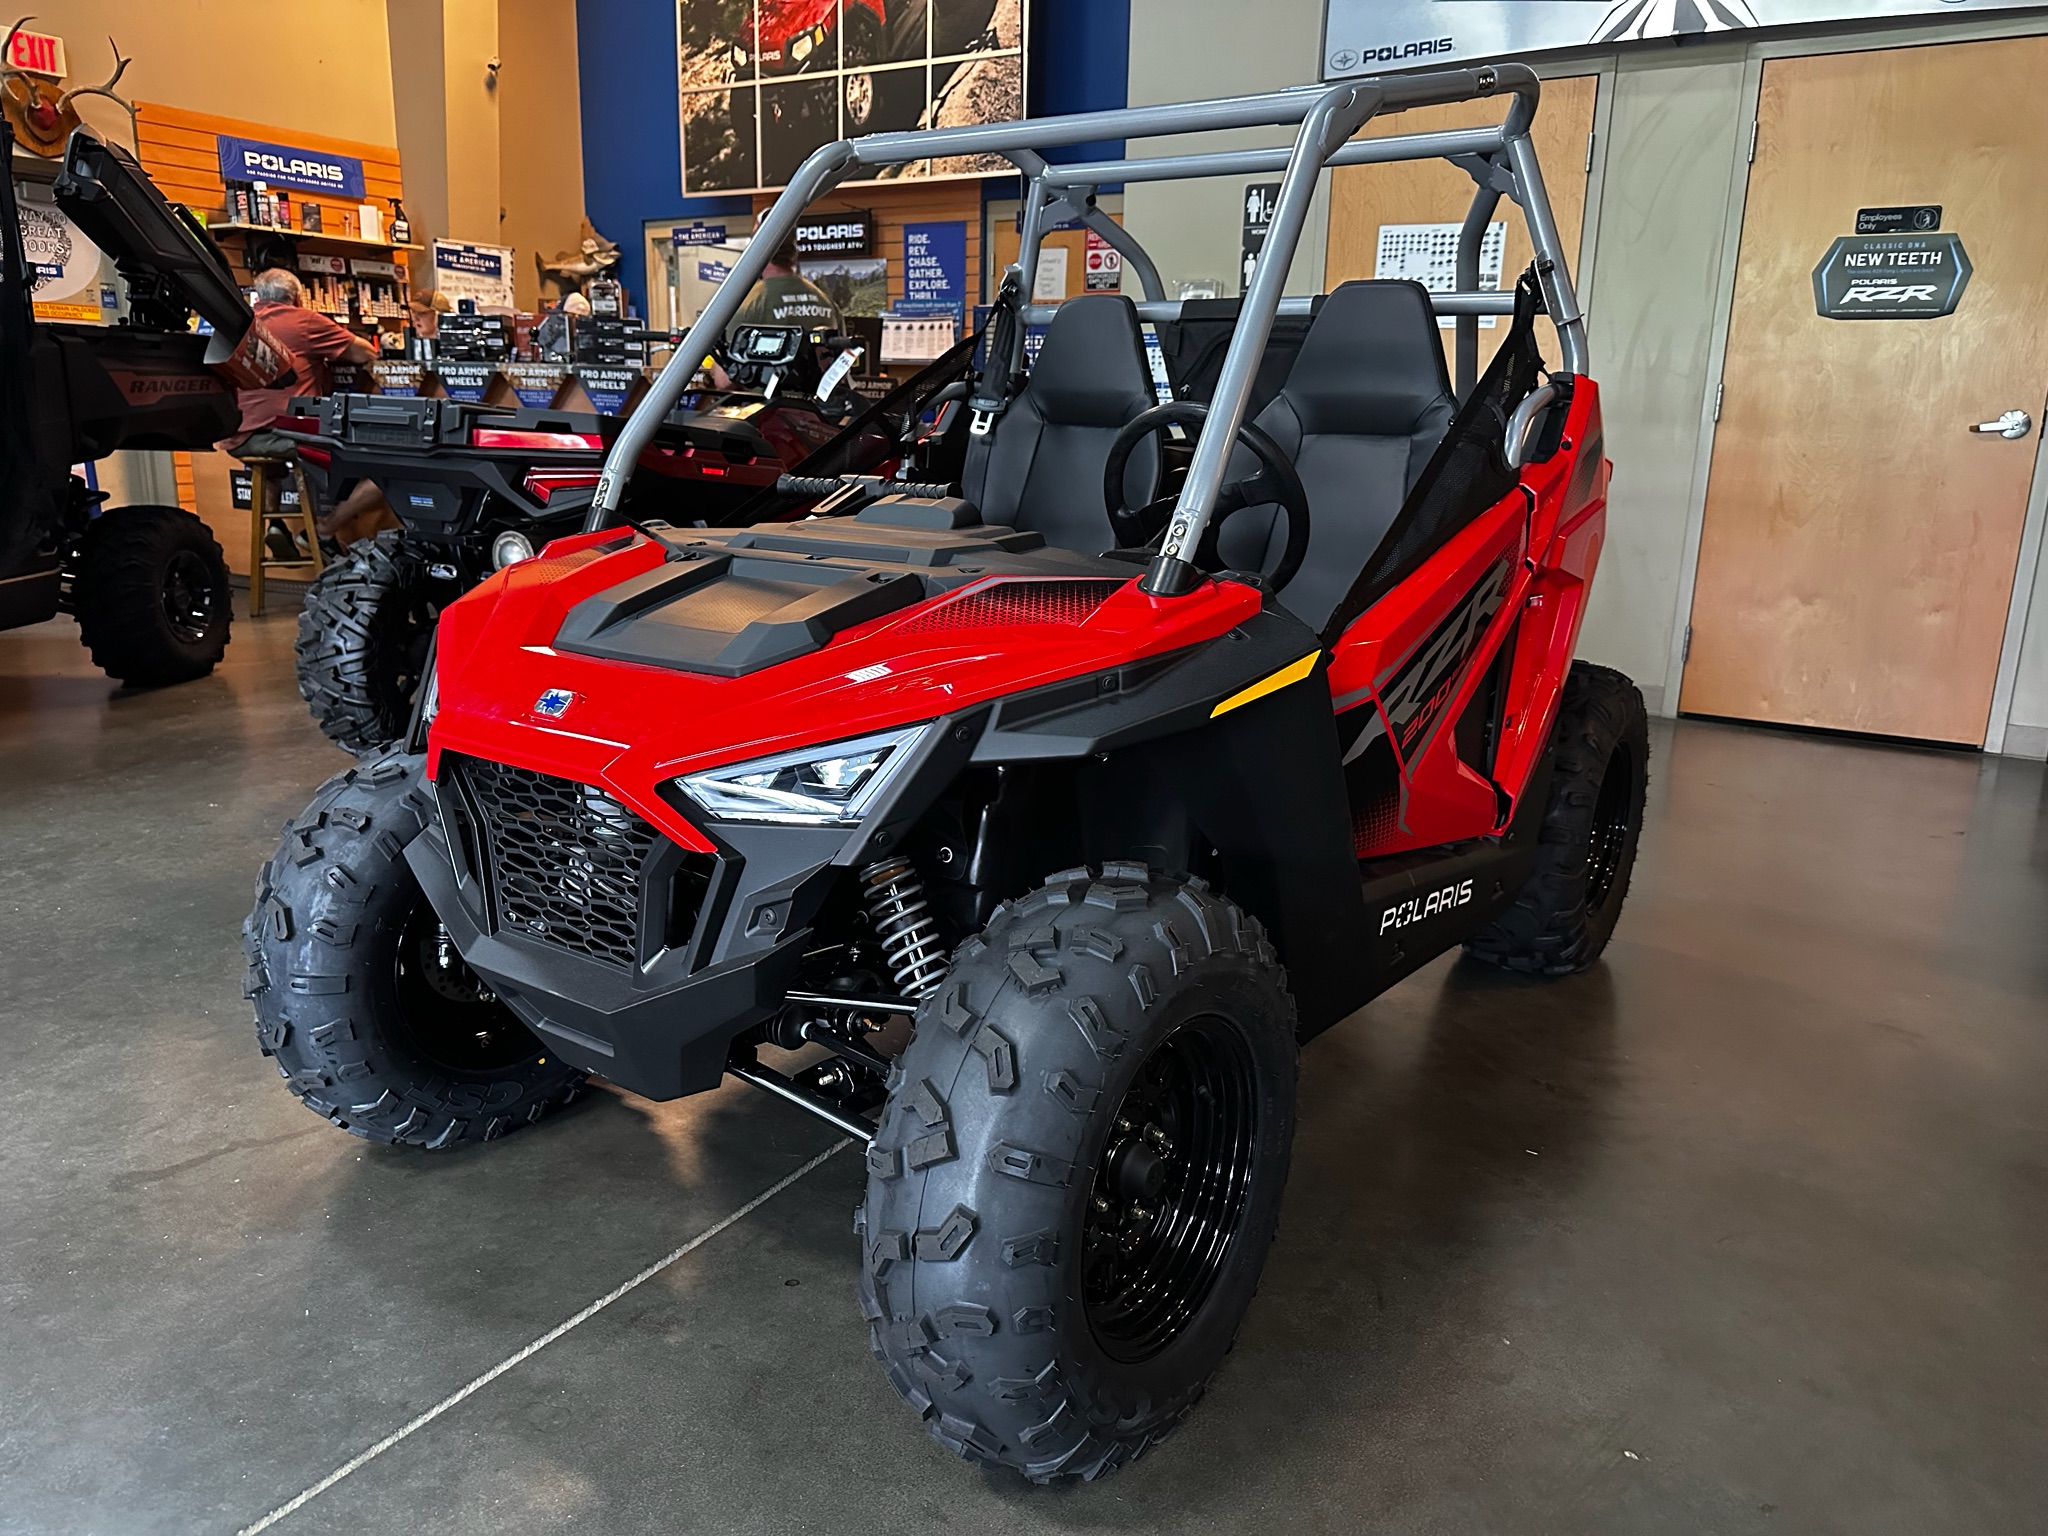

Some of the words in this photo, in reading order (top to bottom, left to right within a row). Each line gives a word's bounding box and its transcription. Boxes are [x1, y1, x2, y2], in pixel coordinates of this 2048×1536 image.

[12, 30, 56, 73] EXIT
[750, 50, 781, 61] PLARIS
[1363, 38, 1453, 64] POLARIS
[244, 151, 344, 181] POLARIS
[51, 213, 67, 225] TO
[1860, 213, 1903, 222] Employees
[20, 225, 61, 238] GREAT
[796, 223, 864, 241] POLARIS
[1858, 222, 1876, 231] Only
[678, 233, 689, 241] THE
[908, 233, 931, 244] RIDE.
[813, 242, 845, 251] TOUGHEST
[908, 245, 928, 256] REV.
[1864, 242, 1903, 250] CLASSIC
[1908, 241, 1927, 249] DNA
[444, 253, 457, 262] THE
[459, 256, 495, 268] AMERICAN
[908, 256, 940, 267] CHASE.
[1845, 253, 1883, 266] NEW
[1887, 251, 1942, 265] TEETH
[908, 268, 945, 279] GATHER.
[908, 279, 950, 290] EXPLORE.
[1839, 285, 1937, 304] RZR
[373, 365, 390, 374] PRO
[391, 365, 420, 374] ARMOR
[439, 366, 457, 375] PRO
[458, 367, 489, 376] ARMOR
[508, 367, 527, 376] PRO
[528, 368, 560, 378] ARMOR
[580, 369, 599, 379] PRO
[600, 370, 633, 381] ARMOR
[385, 375, 410, 384] TIRES
[446, 377, 483, 386] WHEELS
[521, 377, 547, 387] TIRES
[587, 380, 626, 390] WHEELS
[130, 380, 211, 393] RANGER
[1342, 559, 1509, 766] RZR
[1402, 677, 1452, 749] 200
[1380, 879, 1473, 936] POLARIS
